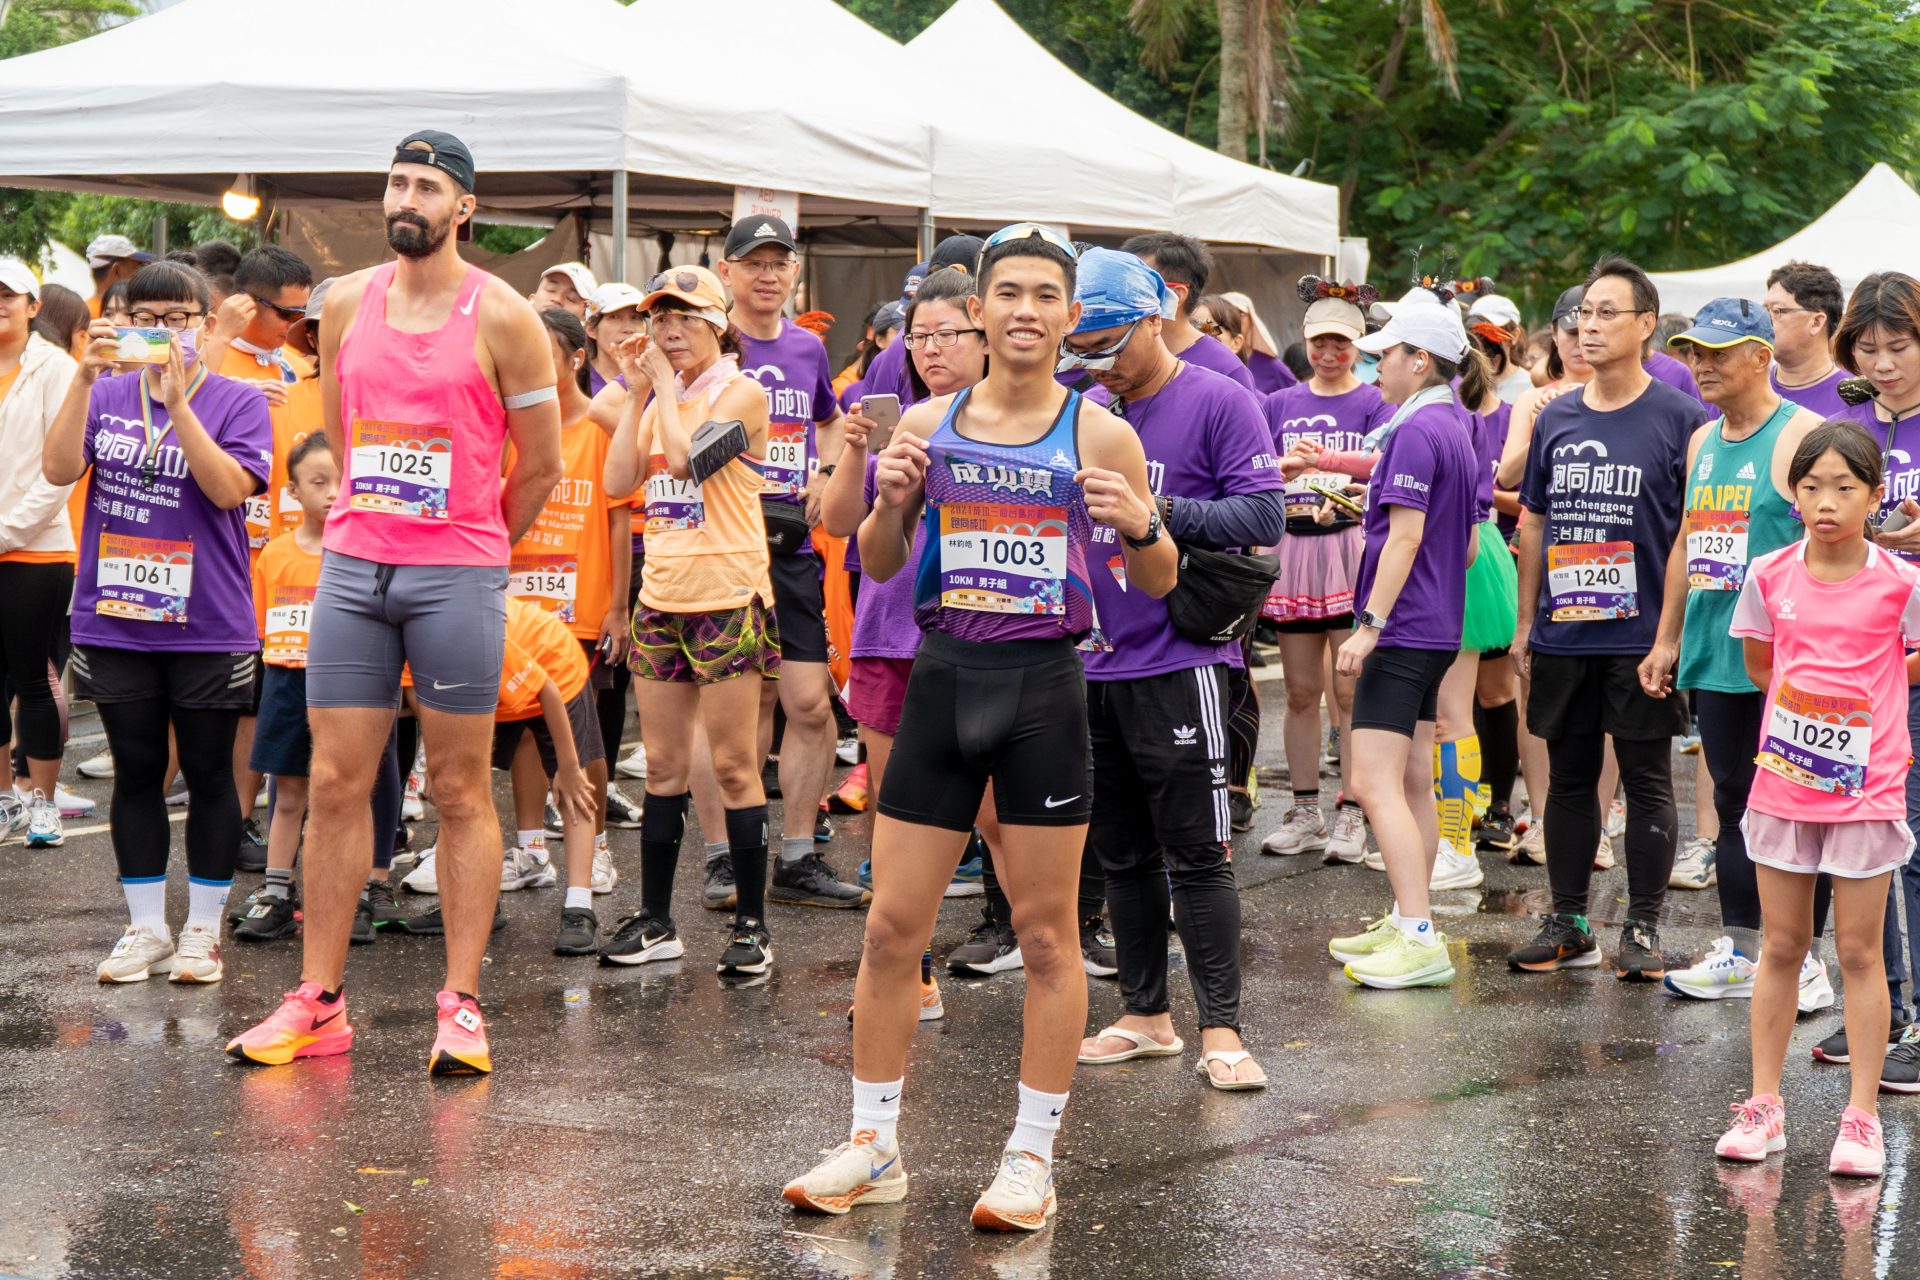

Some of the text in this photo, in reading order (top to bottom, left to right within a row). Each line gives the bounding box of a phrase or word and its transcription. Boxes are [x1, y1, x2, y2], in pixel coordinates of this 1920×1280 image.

[770, 446, 796, 462] 018
[380, 451, 433, 476] 1025
[950, 462, 1053, 492] 成功鎮
[355, 481, 400, 495] 10KM 男子組
[129, 488, 179, 508] Marathon
[1574, 499, 1634, 515] Chenggong
[1693, 485, 1752, 511] TAIPEI
[1588, 512, 1633, 526] Marathon
[980, 538, 1045, 566] 1003
[1699, 536, 1734, 554] 1239
[124, 563, 171, 586] 1061
[949, 575, 1007, 589] 10KM 男子組
[1574, 568, 1621, 587] 1240
[525, 576, 566, 592] 5154
[101, 589, 144, 602] 10KM 女子組
[1555, 596, 1597, 605] 10KM 男子組
[288, 610, 307, 627] 51
[1792, 719, 1851, 752] 1029
[1769, 740, 1813, 768] 10KM 女子組
